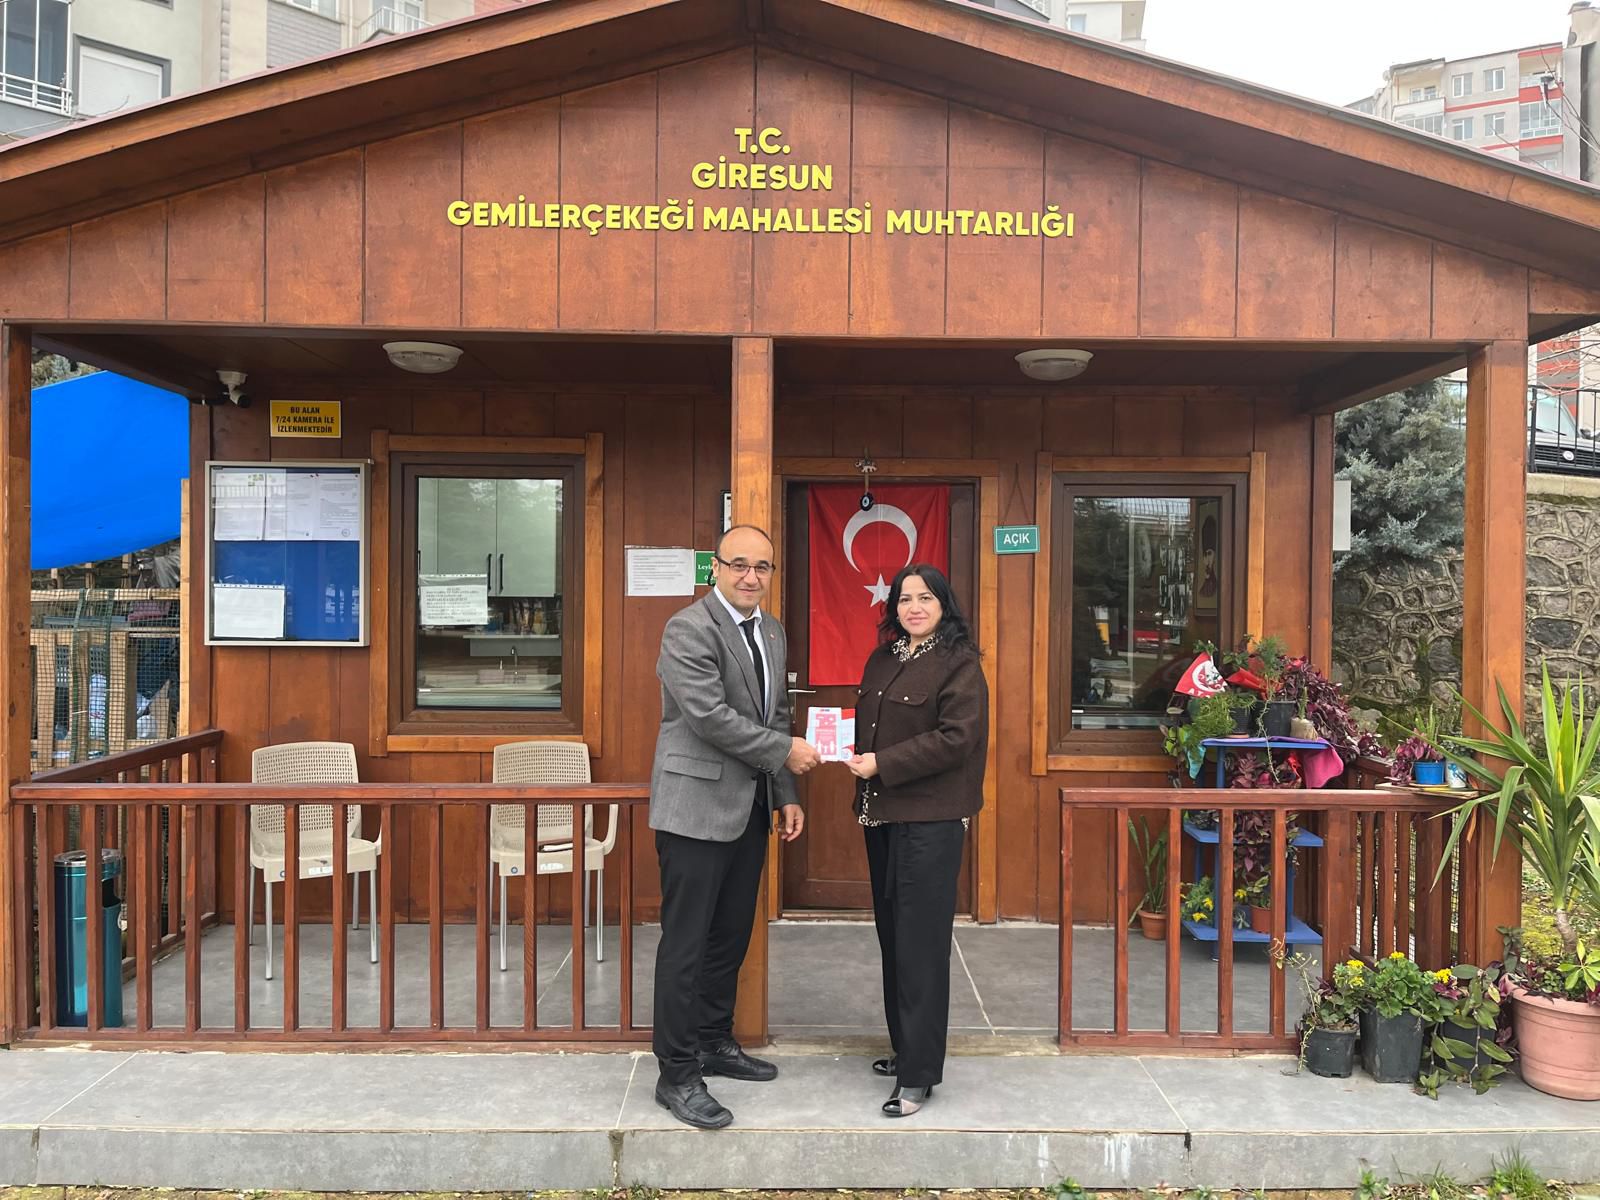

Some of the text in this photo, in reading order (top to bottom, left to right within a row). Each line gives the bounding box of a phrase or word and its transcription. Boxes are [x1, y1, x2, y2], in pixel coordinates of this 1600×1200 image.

[735, 127, 791, 155] T.C.
[691, 156, 834, 191] GİRESUN
[446, 195, 1075, 238] GEMİLERÇEKEĞİ MAHALLESİ MUHTARLIĞI
[290, 406, 320, 414] BU ALAN
[275, 415, 335, 424] 7/24 KAMERA İLE
[277, 424, 333, 433] İZLENMEKTEDİR
[1003, 532, 1031, 547] AÇIK
